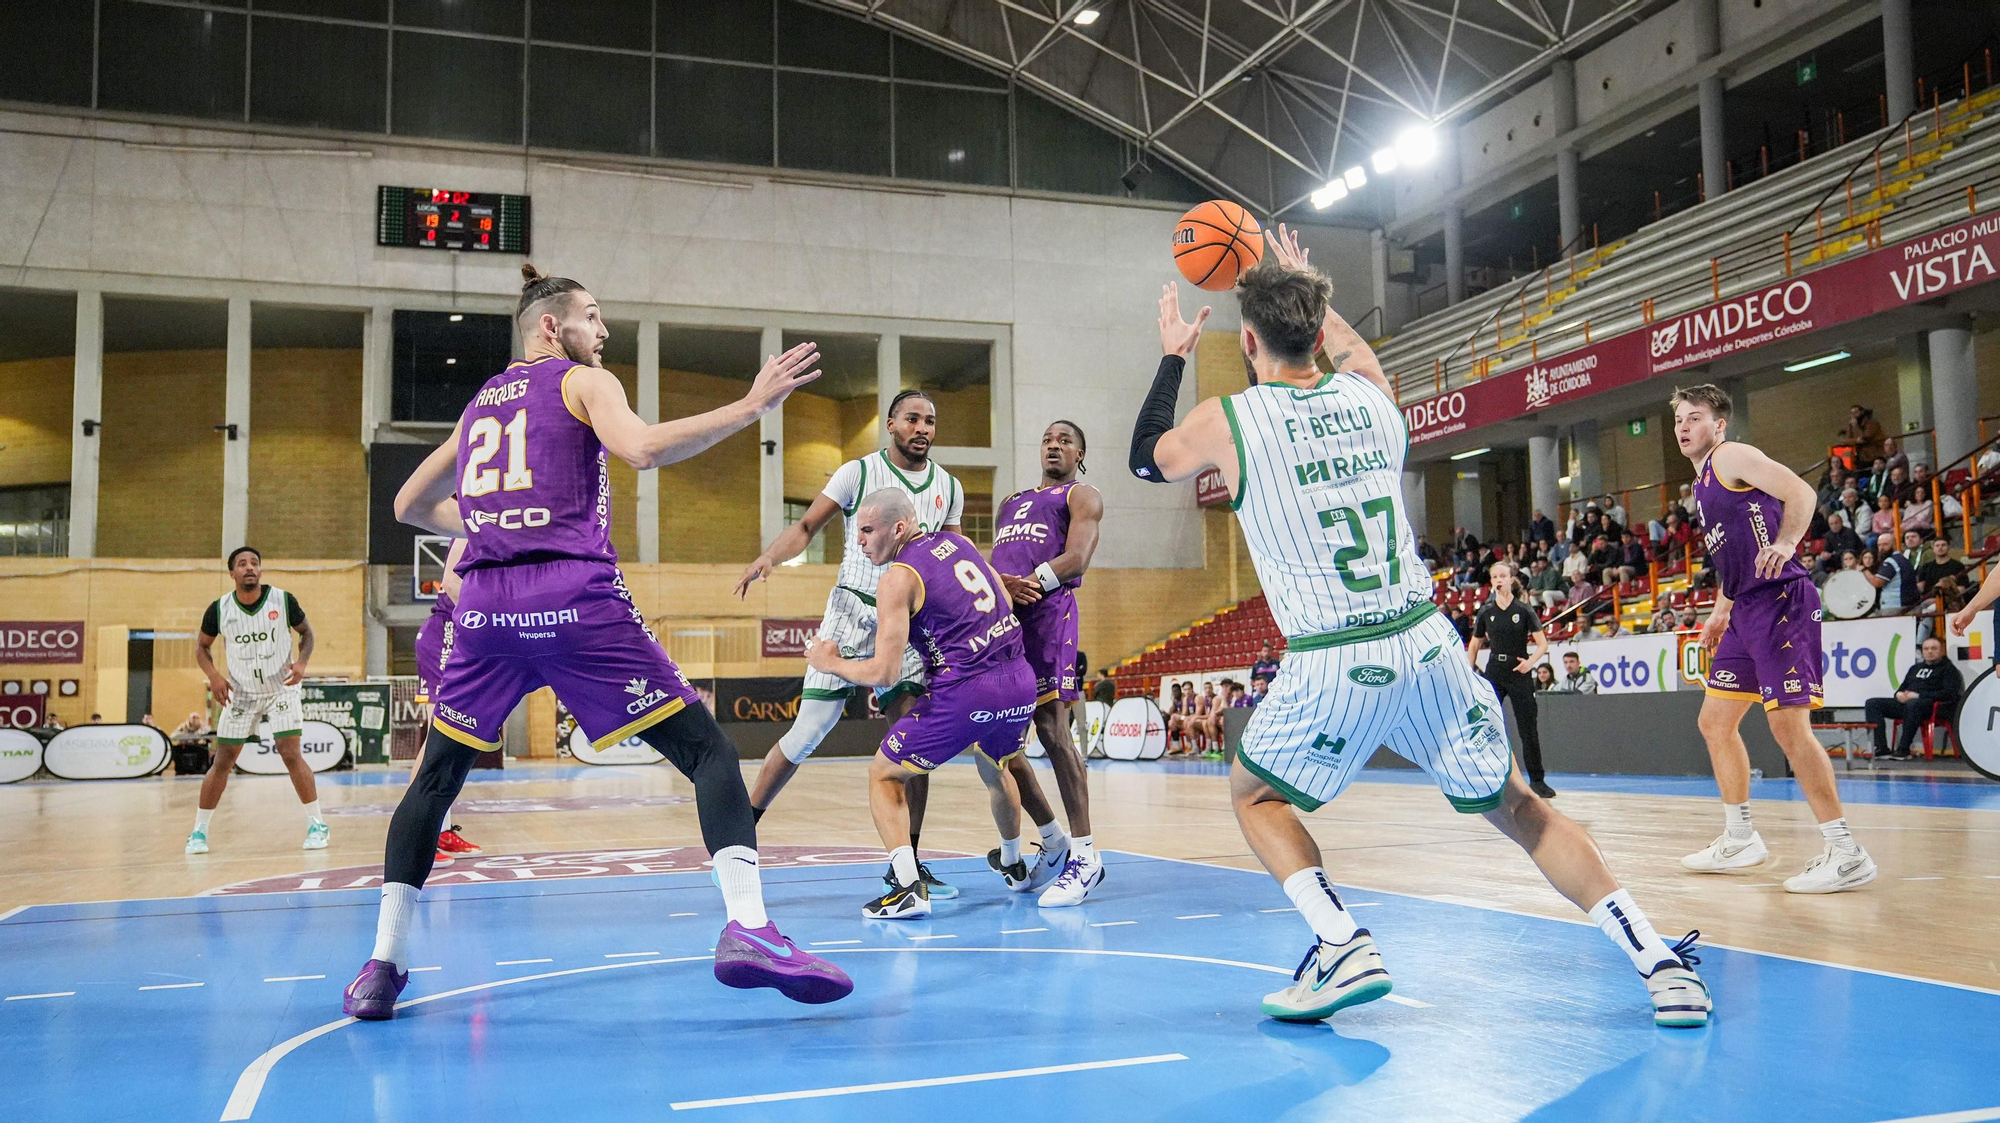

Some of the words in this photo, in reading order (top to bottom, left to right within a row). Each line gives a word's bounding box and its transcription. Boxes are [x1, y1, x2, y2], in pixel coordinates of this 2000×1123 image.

[426, 214, 439, 227] 19
[480, 218, 492, 231] 18
[1904, 229, 1968, 260] PALACIO
[1889, 243, 1997, 300] VISTA
[1683, 280, 1812, 347] IMDECO
[1652, 357, 1683, 373] Instituto
[1684, 343, 1722, 364] Municipal
[1722, 342, 1734, 352] de
[1734, 330, 1774, 350] Deportes
[1774, 319, 1813, 338] Córdoba
[1548, 354, 1598, 381] AYUNTAMIENTO
[1549, 383, 1559, 396] DE
[1285, 418, 1308, 443] F.
[1308, 405, 1373, 439] BELLO
[1632, 422, 1642, 435] B
[461, 407, 533, 497] 21
[1332, 449, 1388, 479] RAHI
[1301, 483, 1339, 495] SOLUCIONES
[1339, 474, 1372, 488] INTEGRALES
[1013, 500, 1033, 520] 2
[1330, 509, 1347, 521] CCB
[930, 538, 959, 561] ISERN
[1317, 496, 1400, 592] 27
[953, 559, 996, 613] 9
[492, 608, 579, 627] HYUNDAI
[235, 631, 268, 644] coto
[518, 631, 557, 640] Hyupersa
[1425, 653, 1448, 673] TYSA
[254, 668, 264, 684] 4
[1357, 667, 1389, 684] Ford
[1709, 679, 1740, 689] HYUNDAI
[1783, 679, 1802, 690] CBC
[626, 688, 669, 715] CRZA
[1109, 719, 1142, 737] CÓRDOBA
[1472, 725, 1497, 749] REALE
[1303, 755, 1339, 770] Arruzafa
[1307, 749, 1342, 763] Hospital
